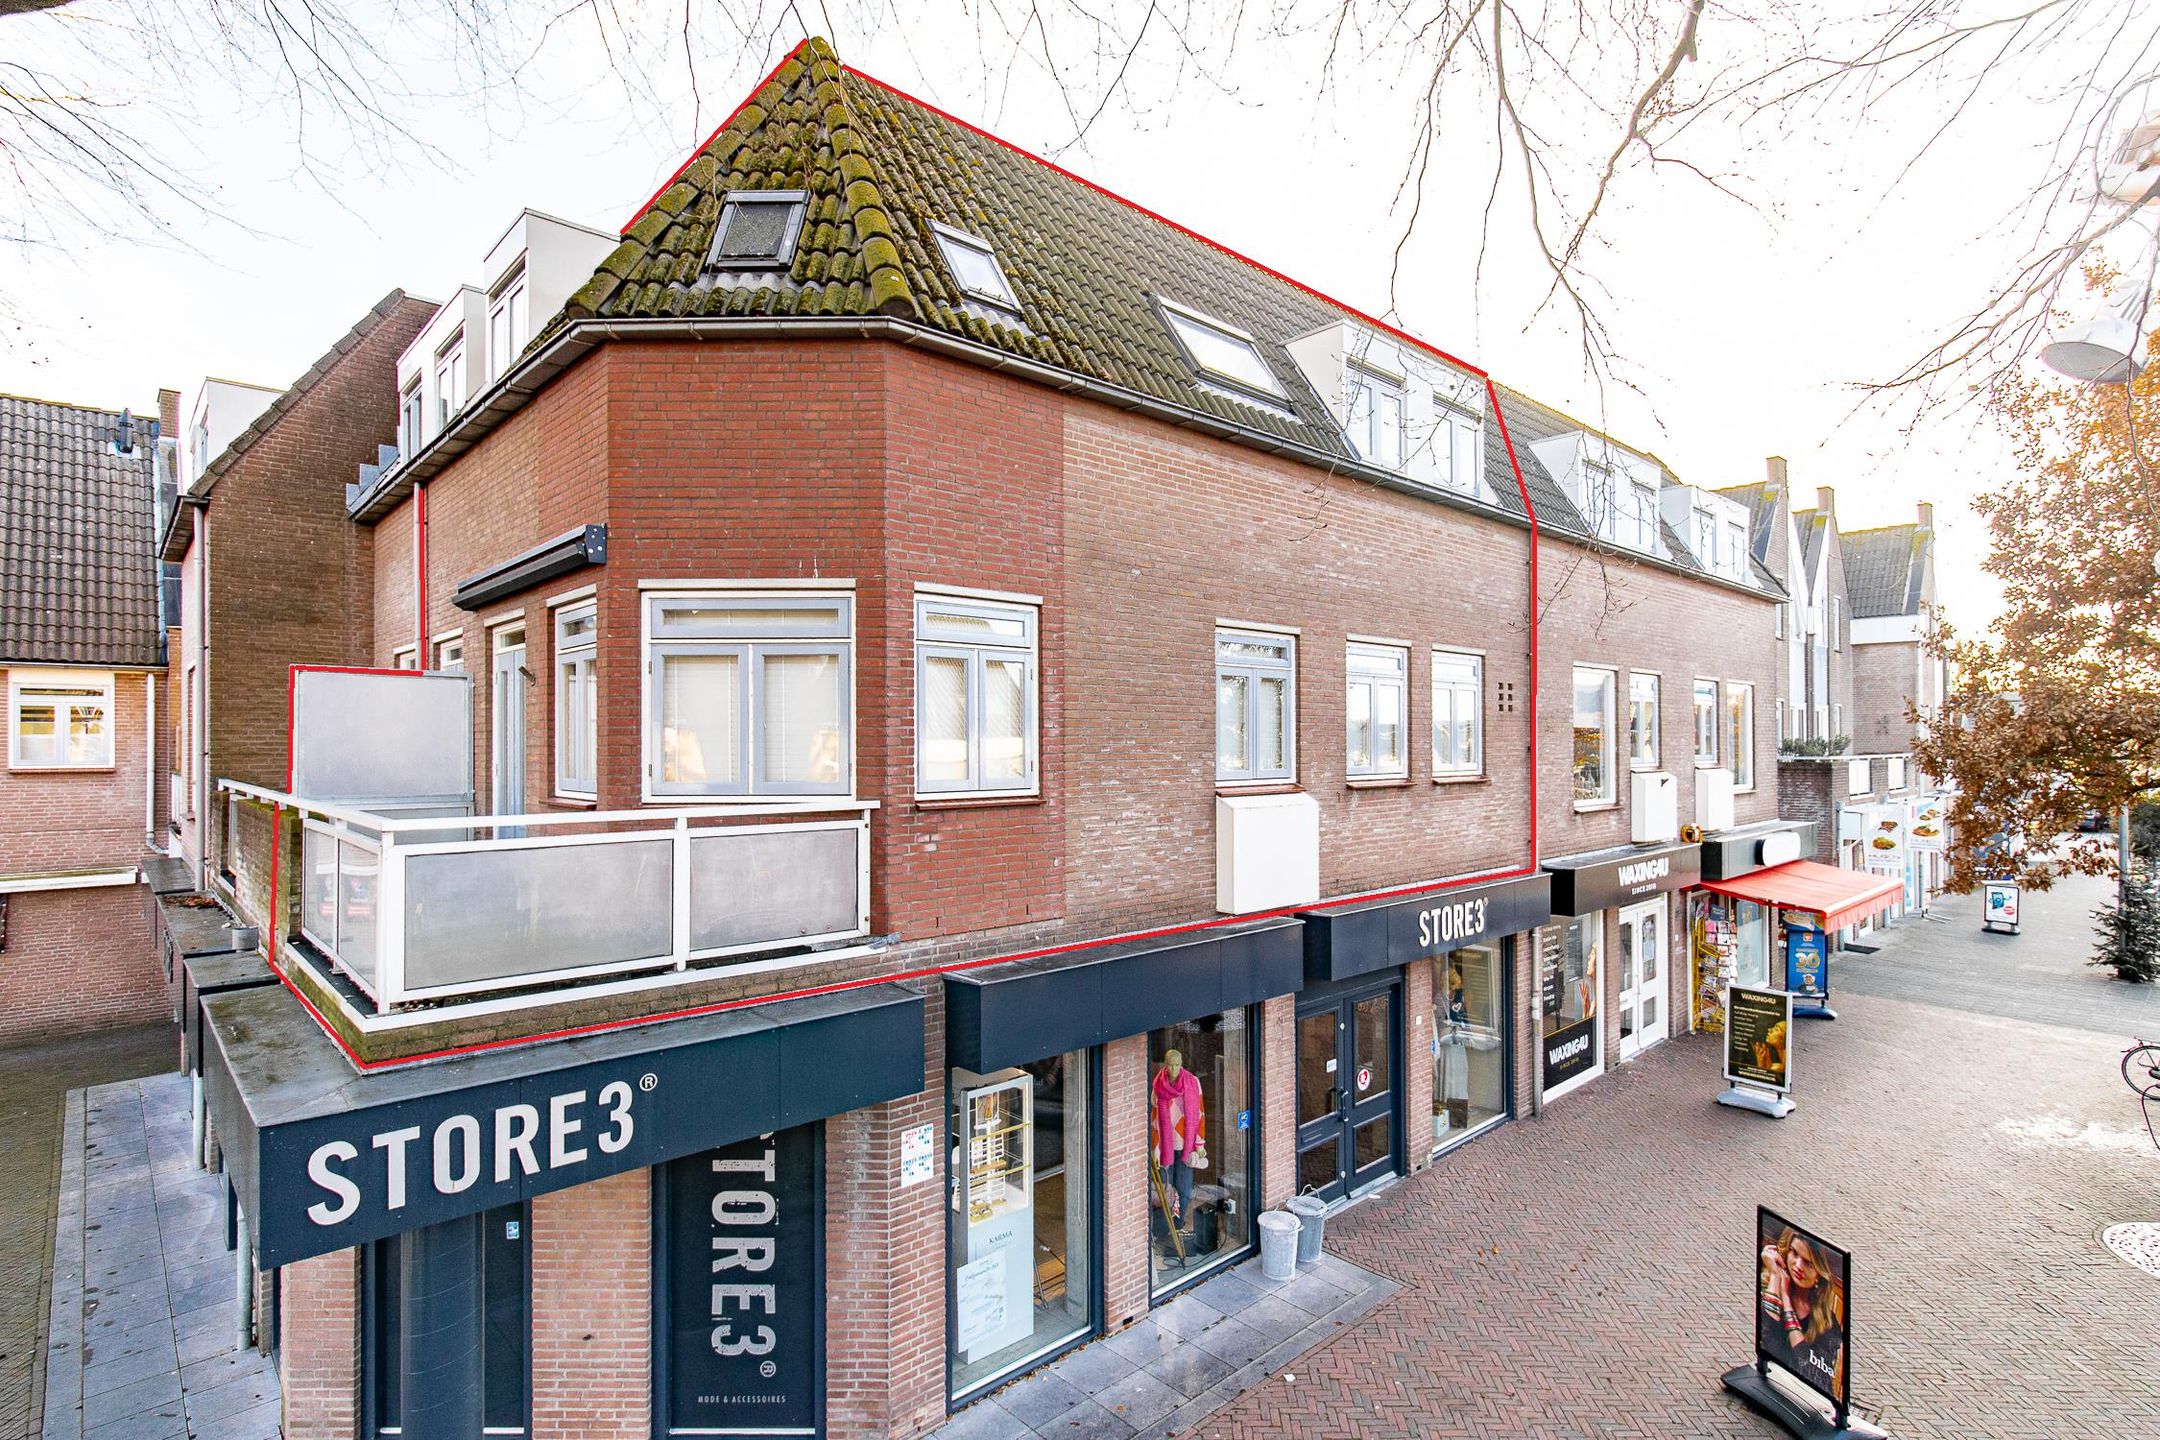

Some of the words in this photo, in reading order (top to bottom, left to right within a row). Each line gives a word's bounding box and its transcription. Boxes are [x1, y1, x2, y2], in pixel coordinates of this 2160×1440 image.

[1618, 857, 1669, 887] WAXING4U
[1549, 1034, 1589, 1065] WAXING4U
[698, 1395, 720, 1404] MODE
[723, 1395, 729, 1404] &
[731, 1395, 786, 1404] ACCESSOIRES
